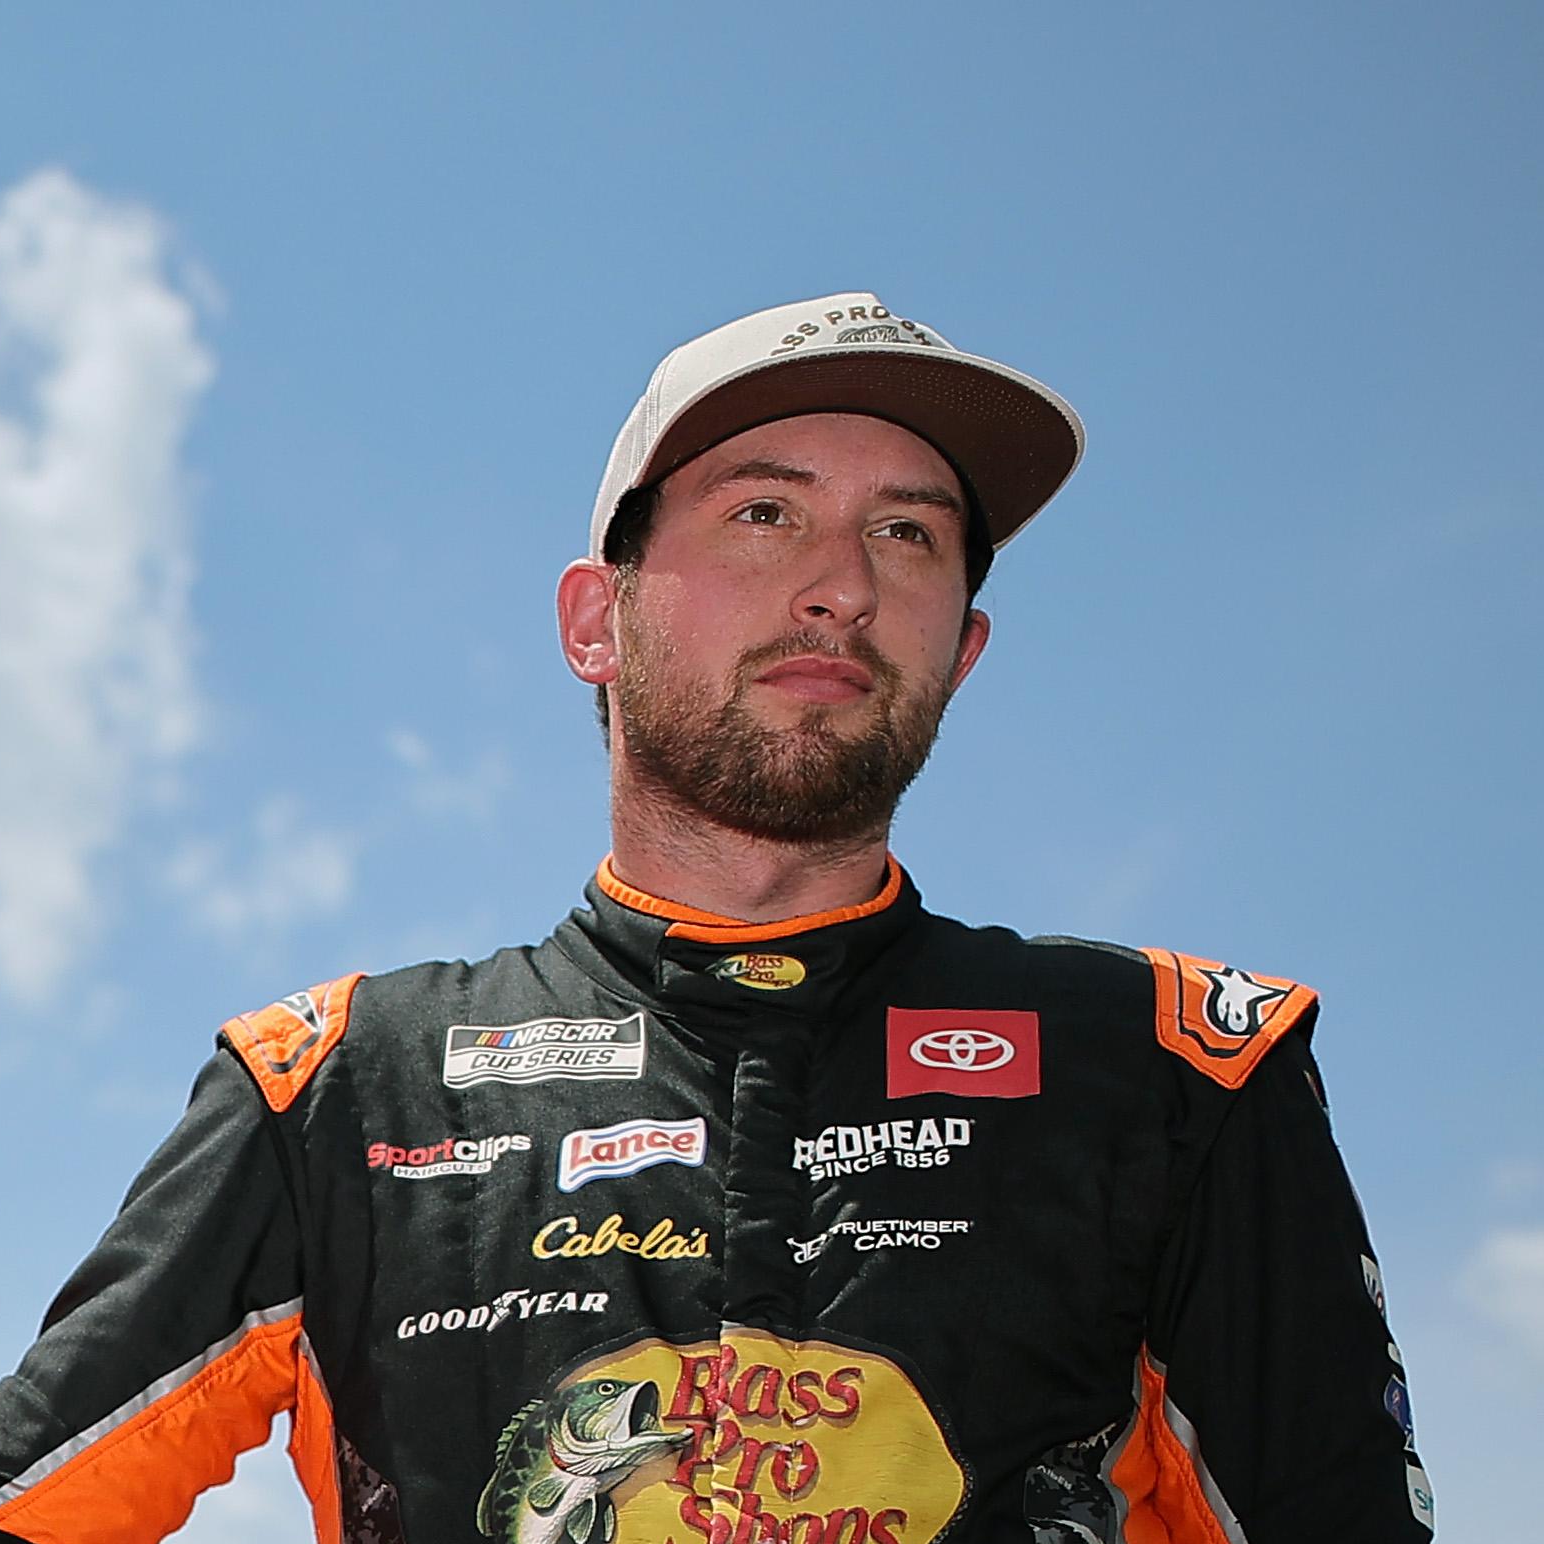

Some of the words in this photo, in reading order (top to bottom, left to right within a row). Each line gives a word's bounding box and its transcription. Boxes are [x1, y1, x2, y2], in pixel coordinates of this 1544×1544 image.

[824, 305, 890, 326] PRO
[510, 1024, 618, 1047] NASCAR
[472, 1052, 526, 1071] CUP
[526, 1048, 617, 1068] SERIES
[366, 1133, 533, 1169] SportClips
[568, 1130, 698, 1171] Lance
[791, 1117, 971, 1171] REDHEAD
[395, 1161, 490, 1178] HAIRCUTS
[809, 1150, 888, 1182] SINCE
[892, 1148, 951, 1169] 1856
[532, 1213, 710, 1260] Cabela's
[853, 1233, 942, 1252] CAMO
[663, 1343, 865, 1425] Bass
[665, 1418, 820, 1497] Pro
